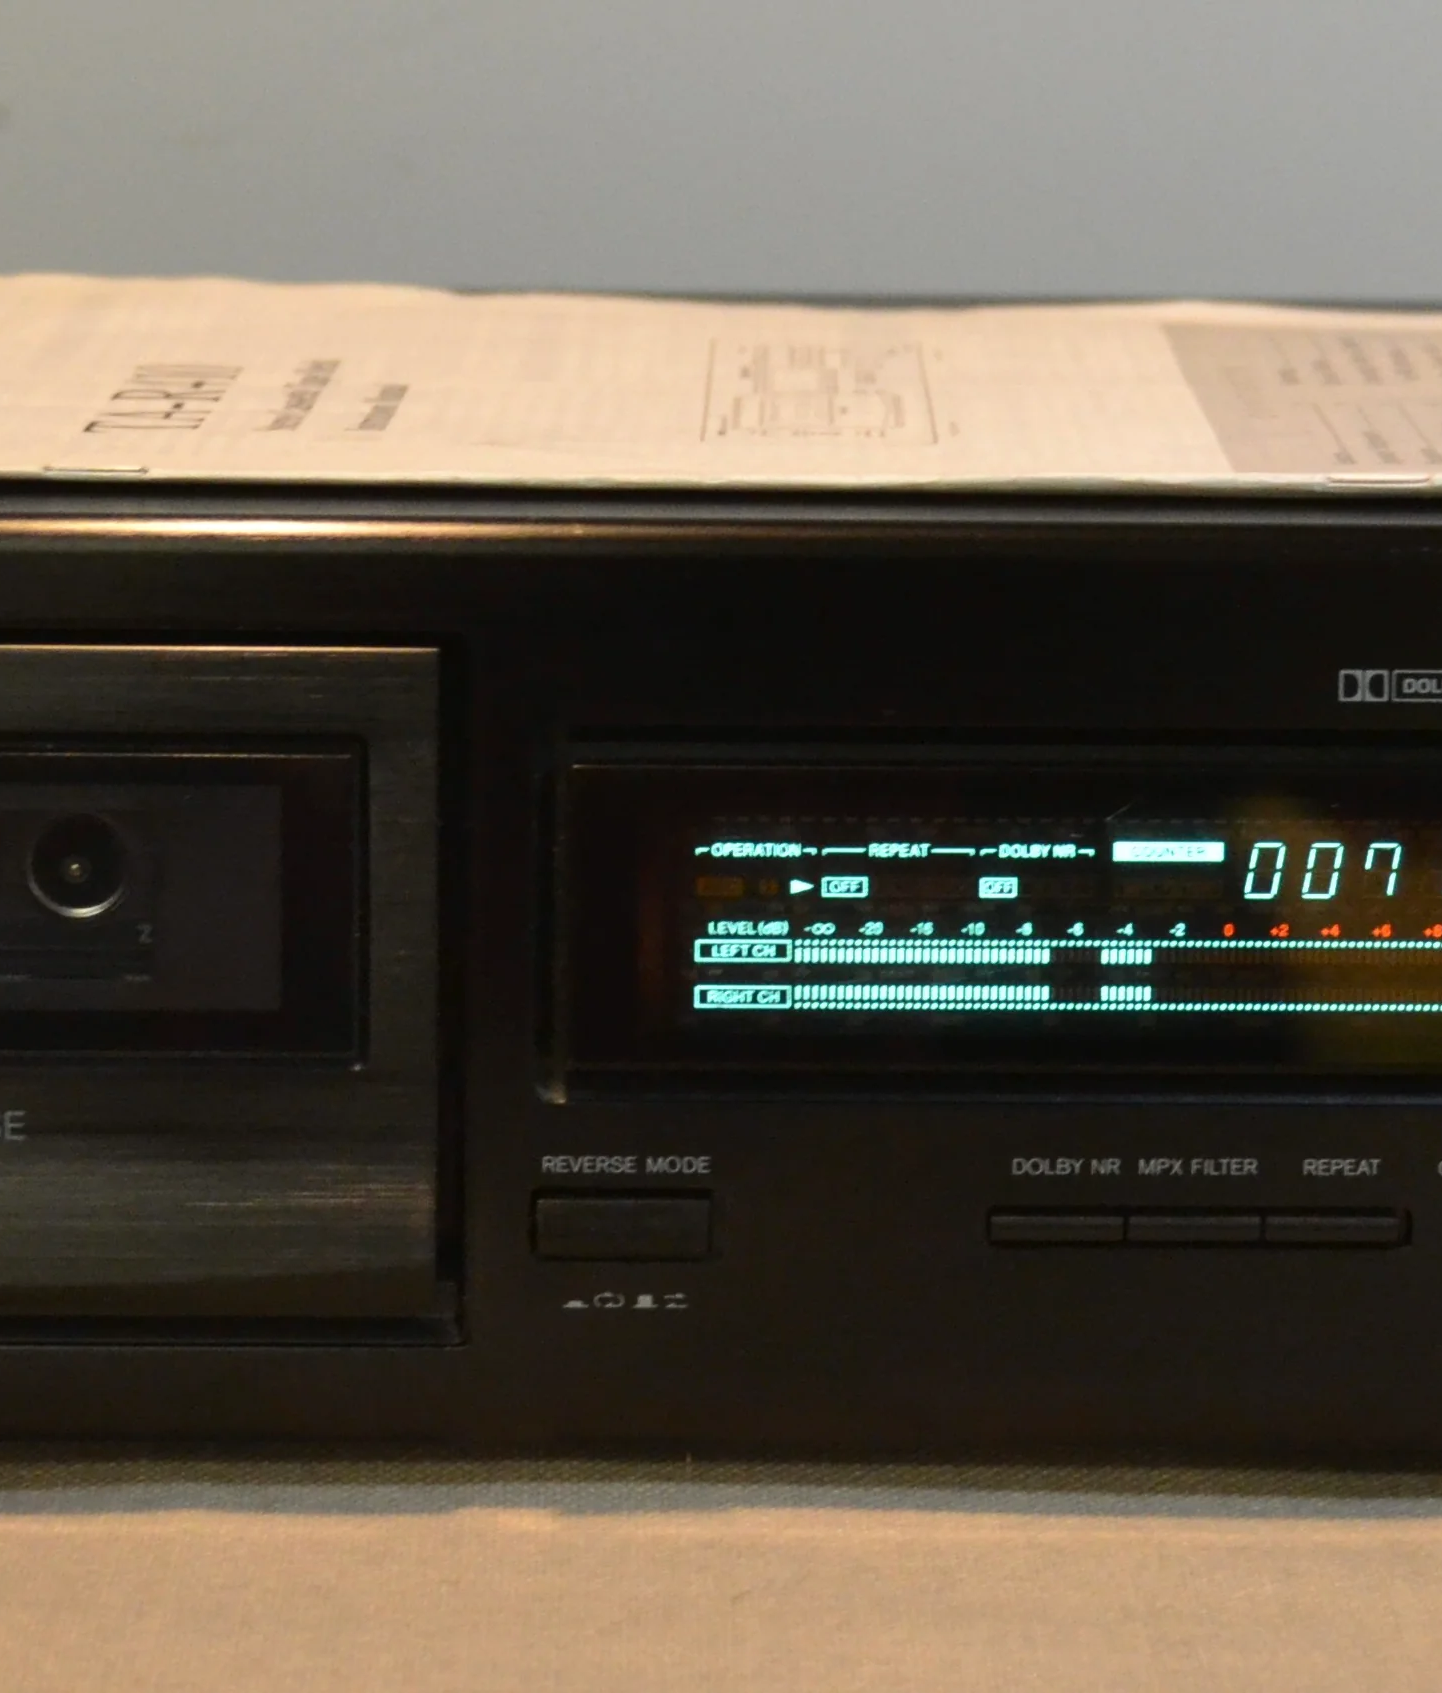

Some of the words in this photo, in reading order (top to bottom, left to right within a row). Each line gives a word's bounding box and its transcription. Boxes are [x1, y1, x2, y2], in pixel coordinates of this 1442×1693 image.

[709, 841, 802, 859] OPERATION
[867, 842, 930, 859] REPEAT
[998, 843, 1051, 859] DOLBY
[1051, 843, 1077, 859] NR
[827, 879, 862, 895] OFF
[983, 880, 1013, 895] OFF
[858, 921, 884, 936] -20
[1116, 922, 1134, 937] -4
[1169, 922, 1186, 938] -2
[1223, 923, 1235, 938] 0
[1269, 923, 1290, 938] +2
[1320, 923, 1341, 938] +4
[711, 943, 751, 959] LEFT
[751, 943, 776, 959] CH
[706, 989, 755, 1005] RIGHT
[756, 989, 781, 1005] CH
[541, 1155, 637, 1174] REVERSE
[645, 1155, 711, 1174] MODE
[1011, 1157, 1084, 1176] DOLBY
[1090, 1157, 1122, 1175] NR
[1138, 1157, 1183, 1175] MPX
[1190, 1157, 1259, 1176] FILTER
[1302, 1158, 1381, 1177] REPEAT
